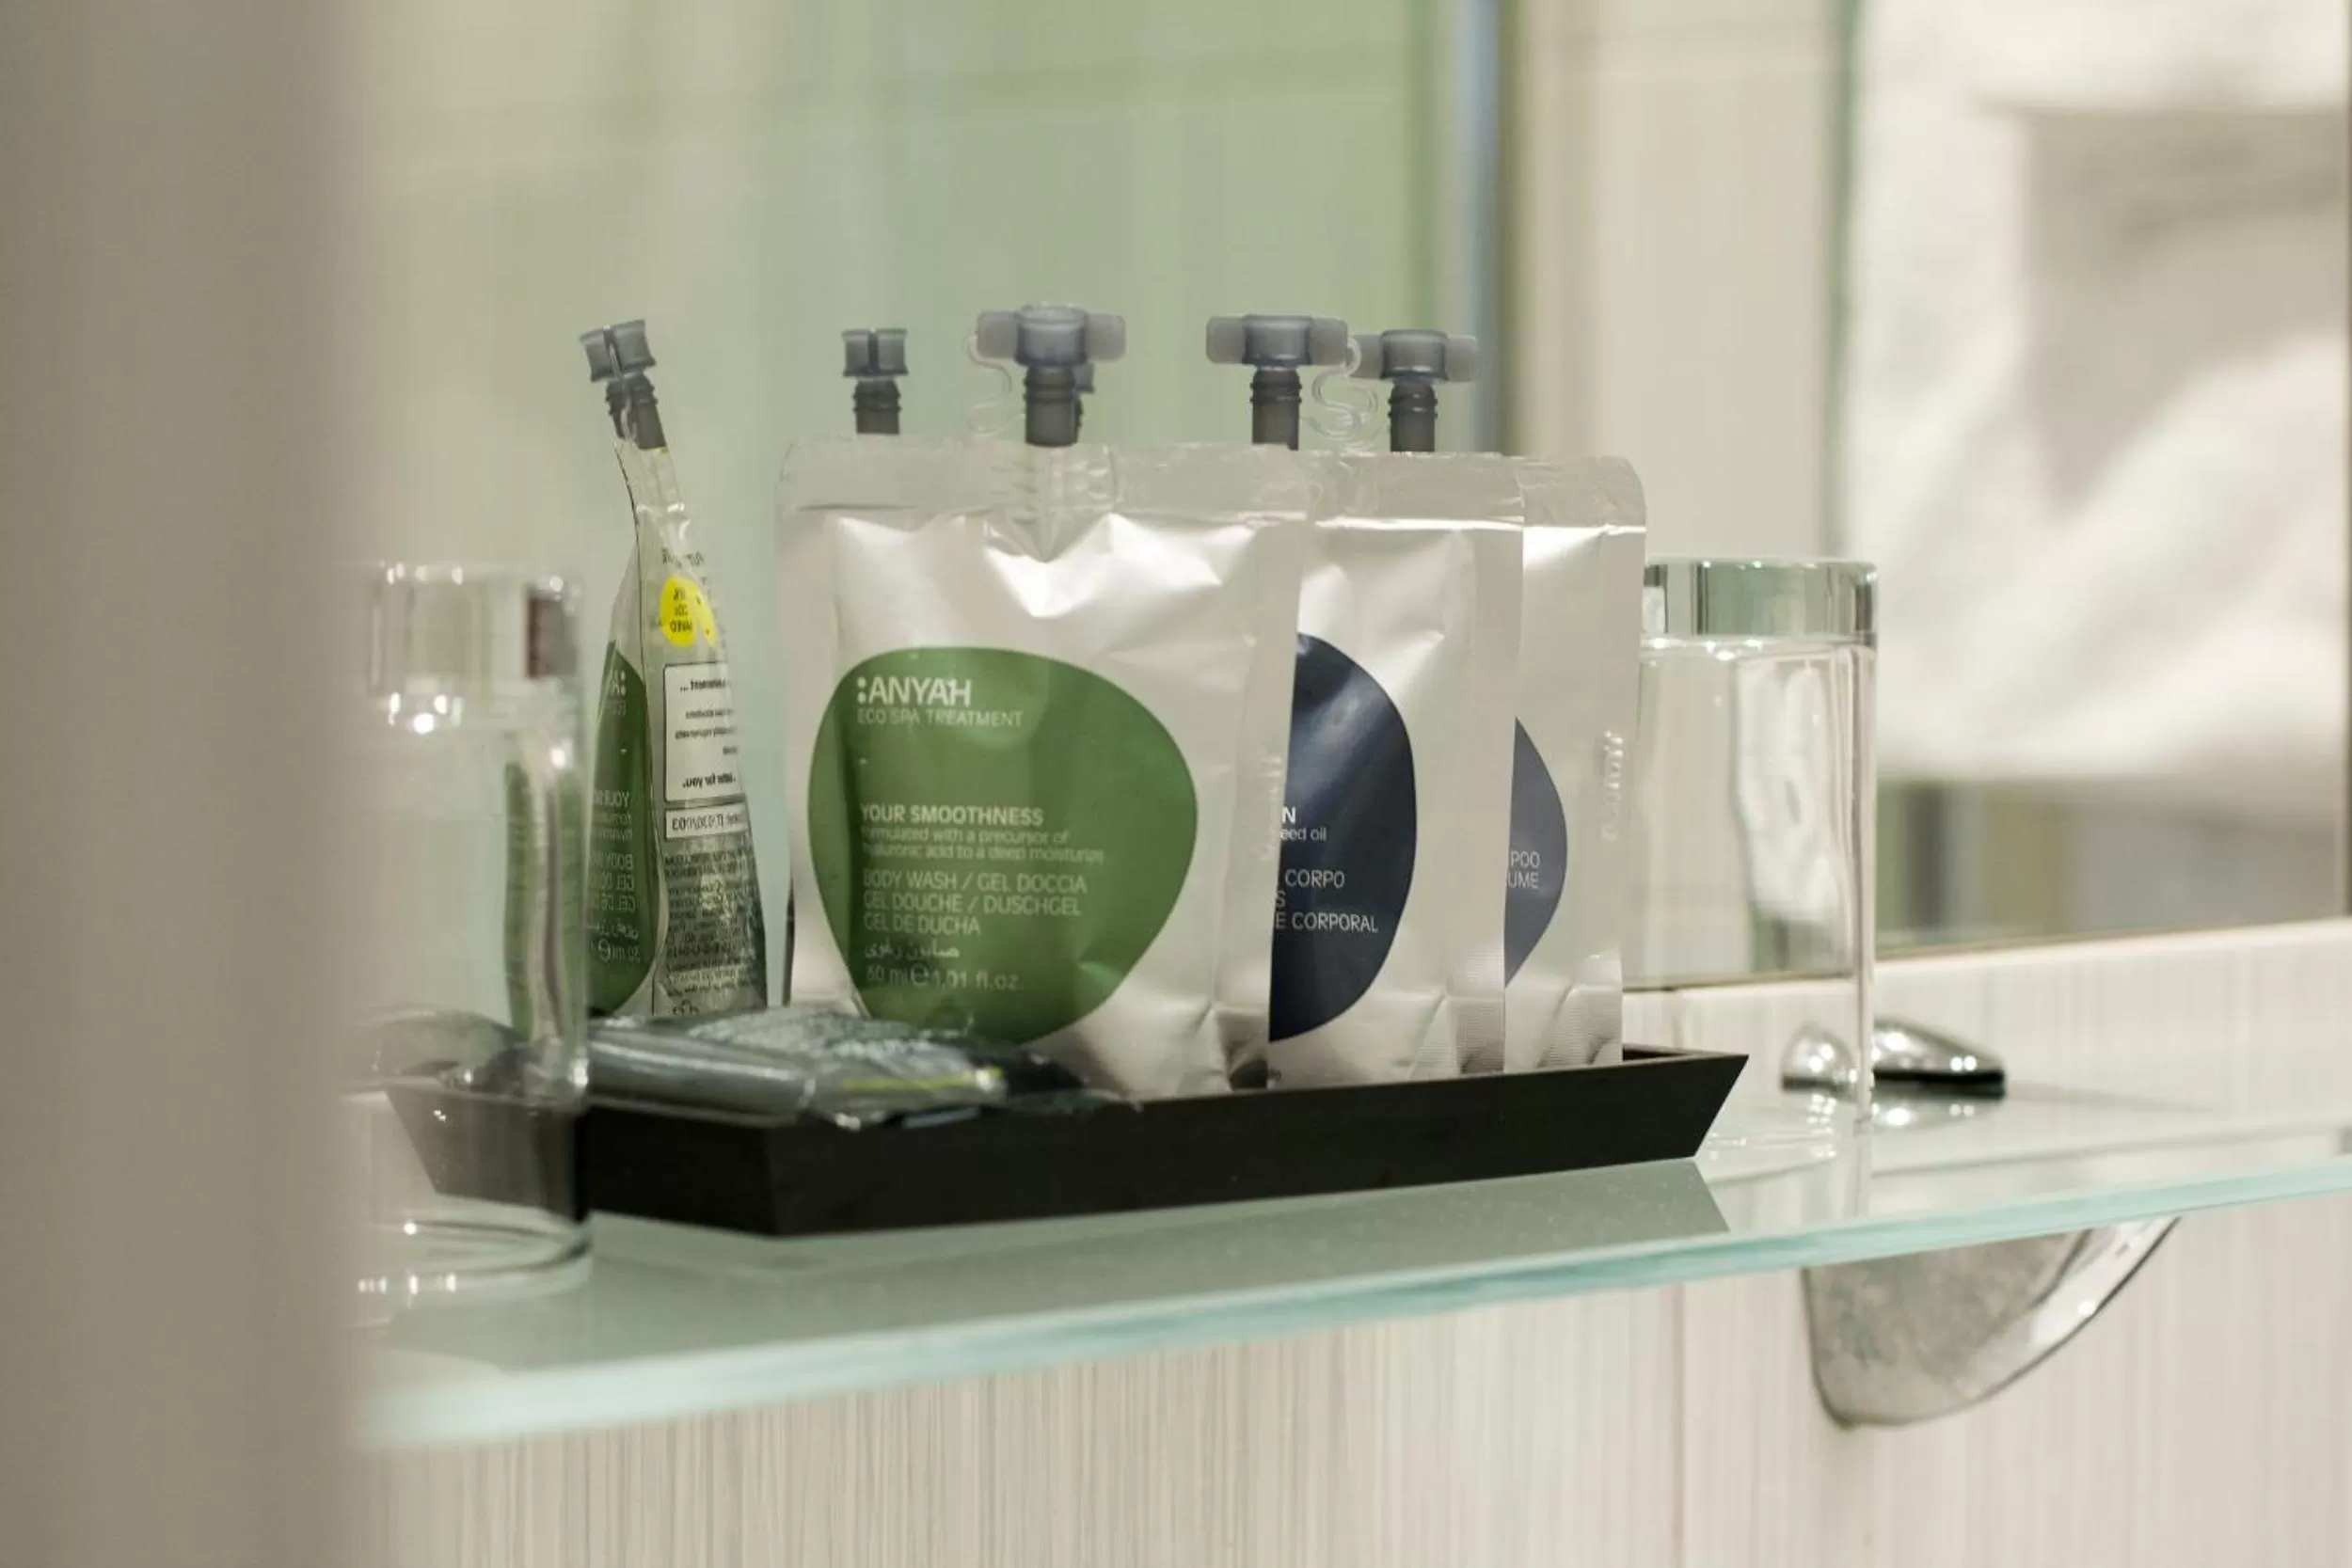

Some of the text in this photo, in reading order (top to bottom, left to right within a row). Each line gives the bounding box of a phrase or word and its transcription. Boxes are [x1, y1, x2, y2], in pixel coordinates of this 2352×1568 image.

[857, 707, 1024, 728] ECO SPA TREATMENT
[861, 803, 1044, 827] YOUR SMOOTHNESS
[932, 829, 963, 844] with
[1053, 829, 1071, 845] of
[1310, 827, 1327, 842] oil
[957, 845, 975, 860] to
[864, 869, 1089, 895] BODY WASH / GEL DOCCIA
[1285, 868, 1345, 889] CORPO
[864, 890, 889, 910] GEL
[892, 892, 964, 913] DOUCHE
[983, 895, 1084, 917] DUSCHGEL
[864, 911, 982, 936] GEL DE DUCHA
[1292, 911, 1379, 934] CORPORAL
